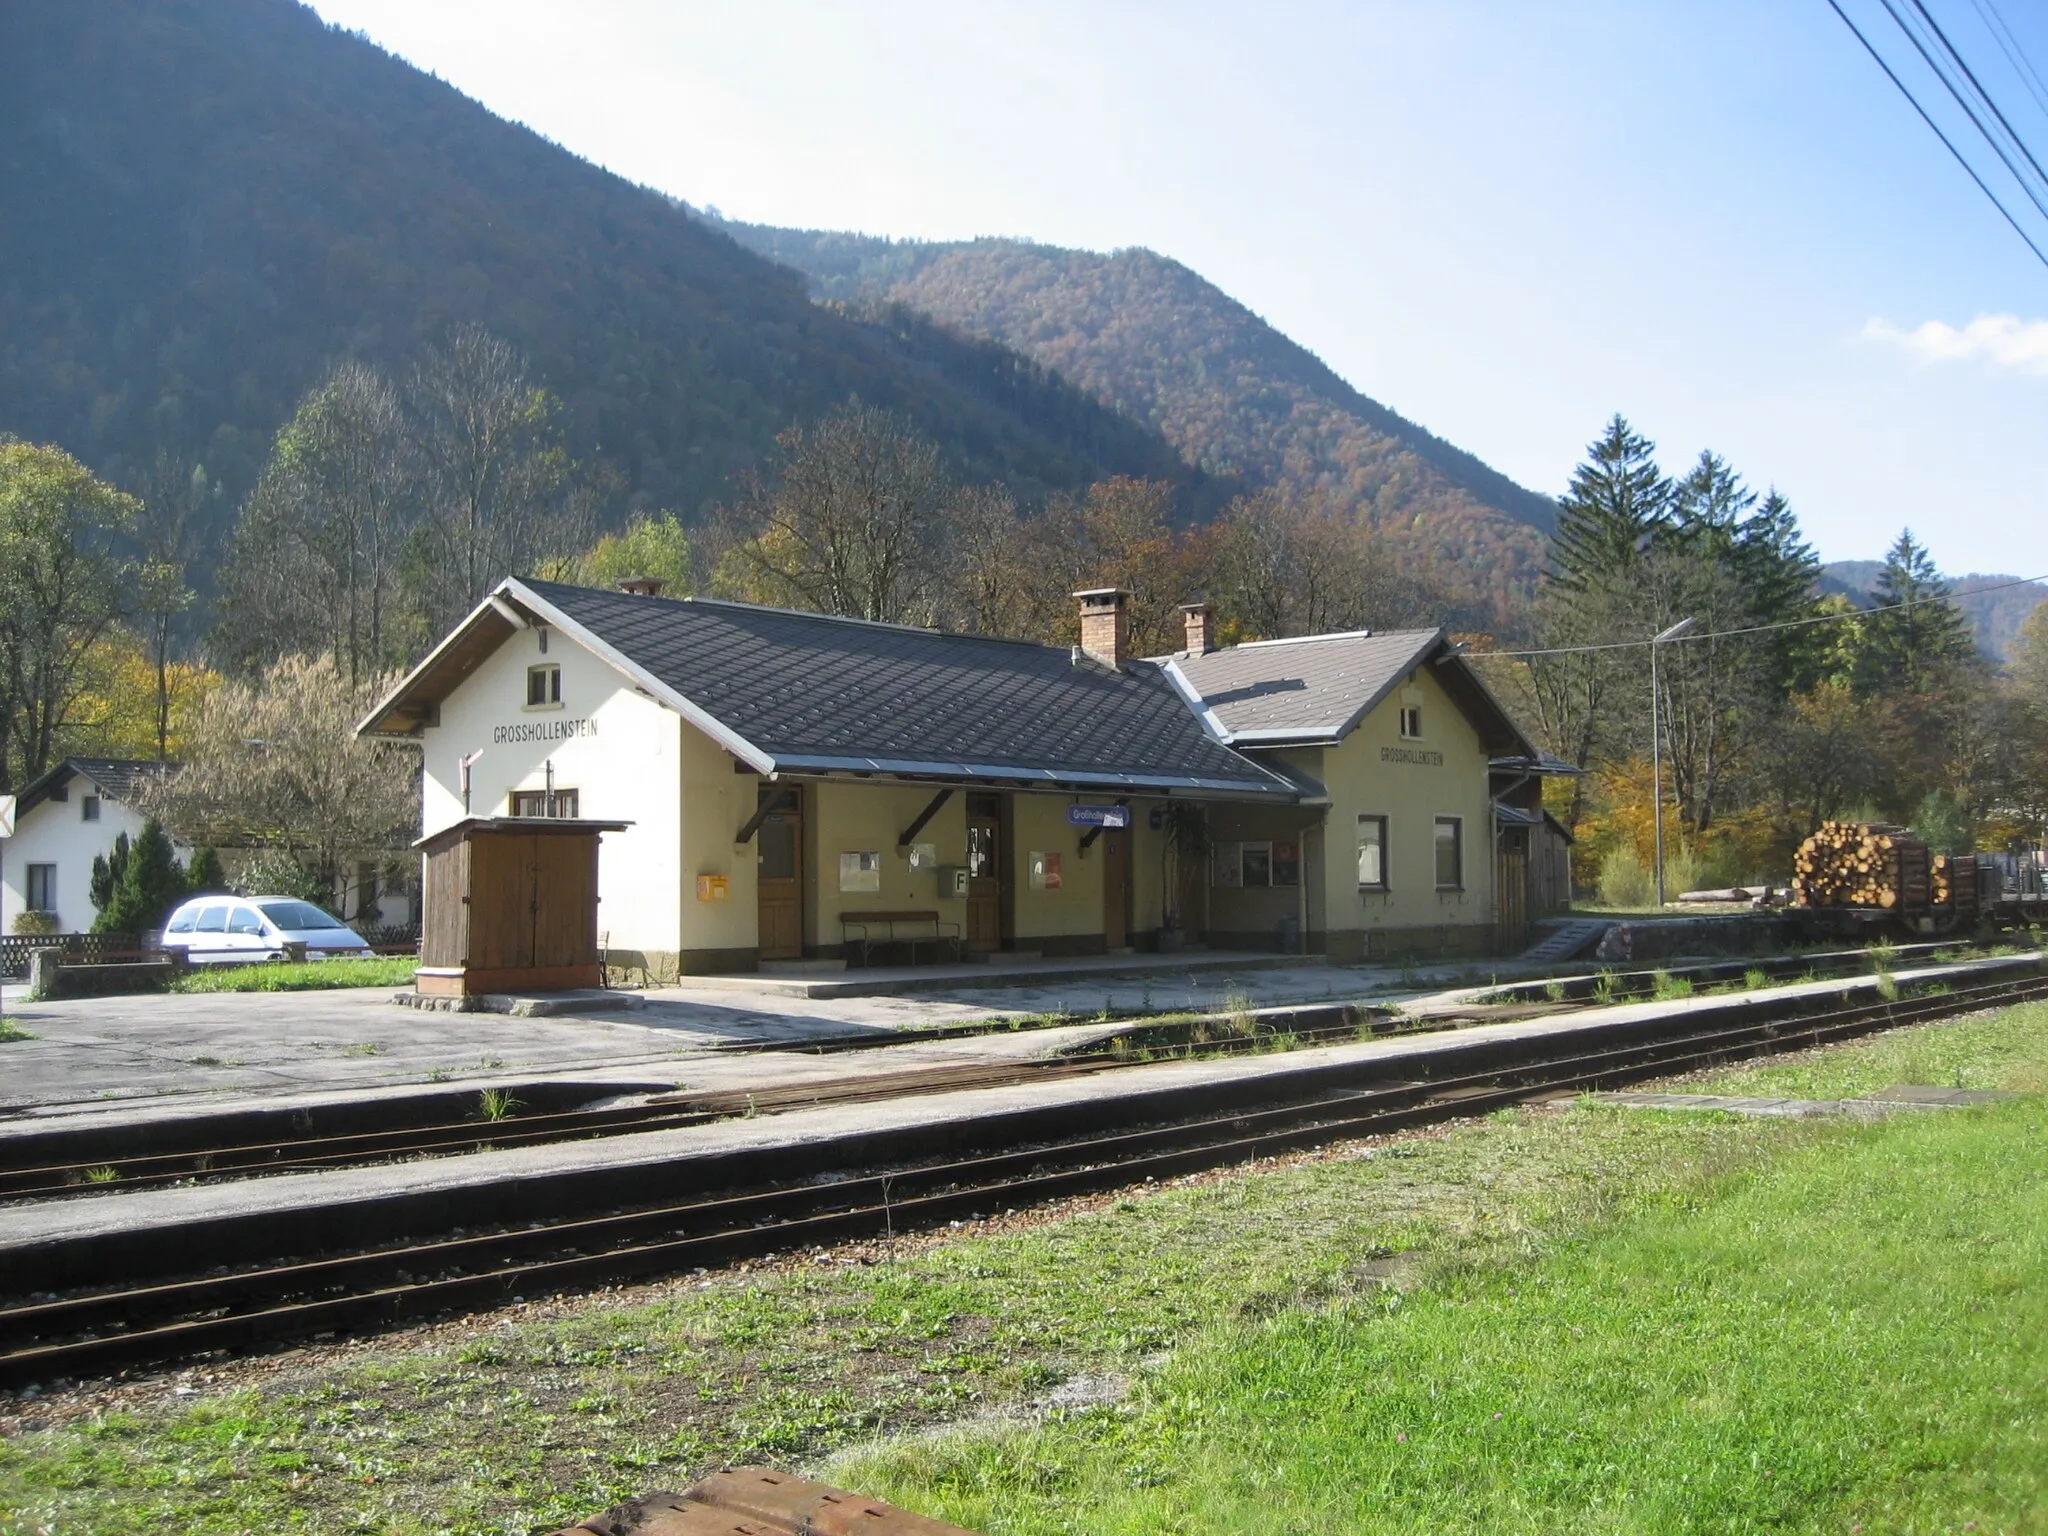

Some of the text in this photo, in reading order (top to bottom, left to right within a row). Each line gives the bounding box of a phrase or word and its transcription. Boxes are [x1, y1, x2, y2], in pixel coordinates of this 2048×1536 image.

[494, 719, 598, 744] GROSSHOLLENSTEIN
[1381, 746, 1444, 767] GROSSHOLLENSTEIN
[956, 872, 965, 890] F
